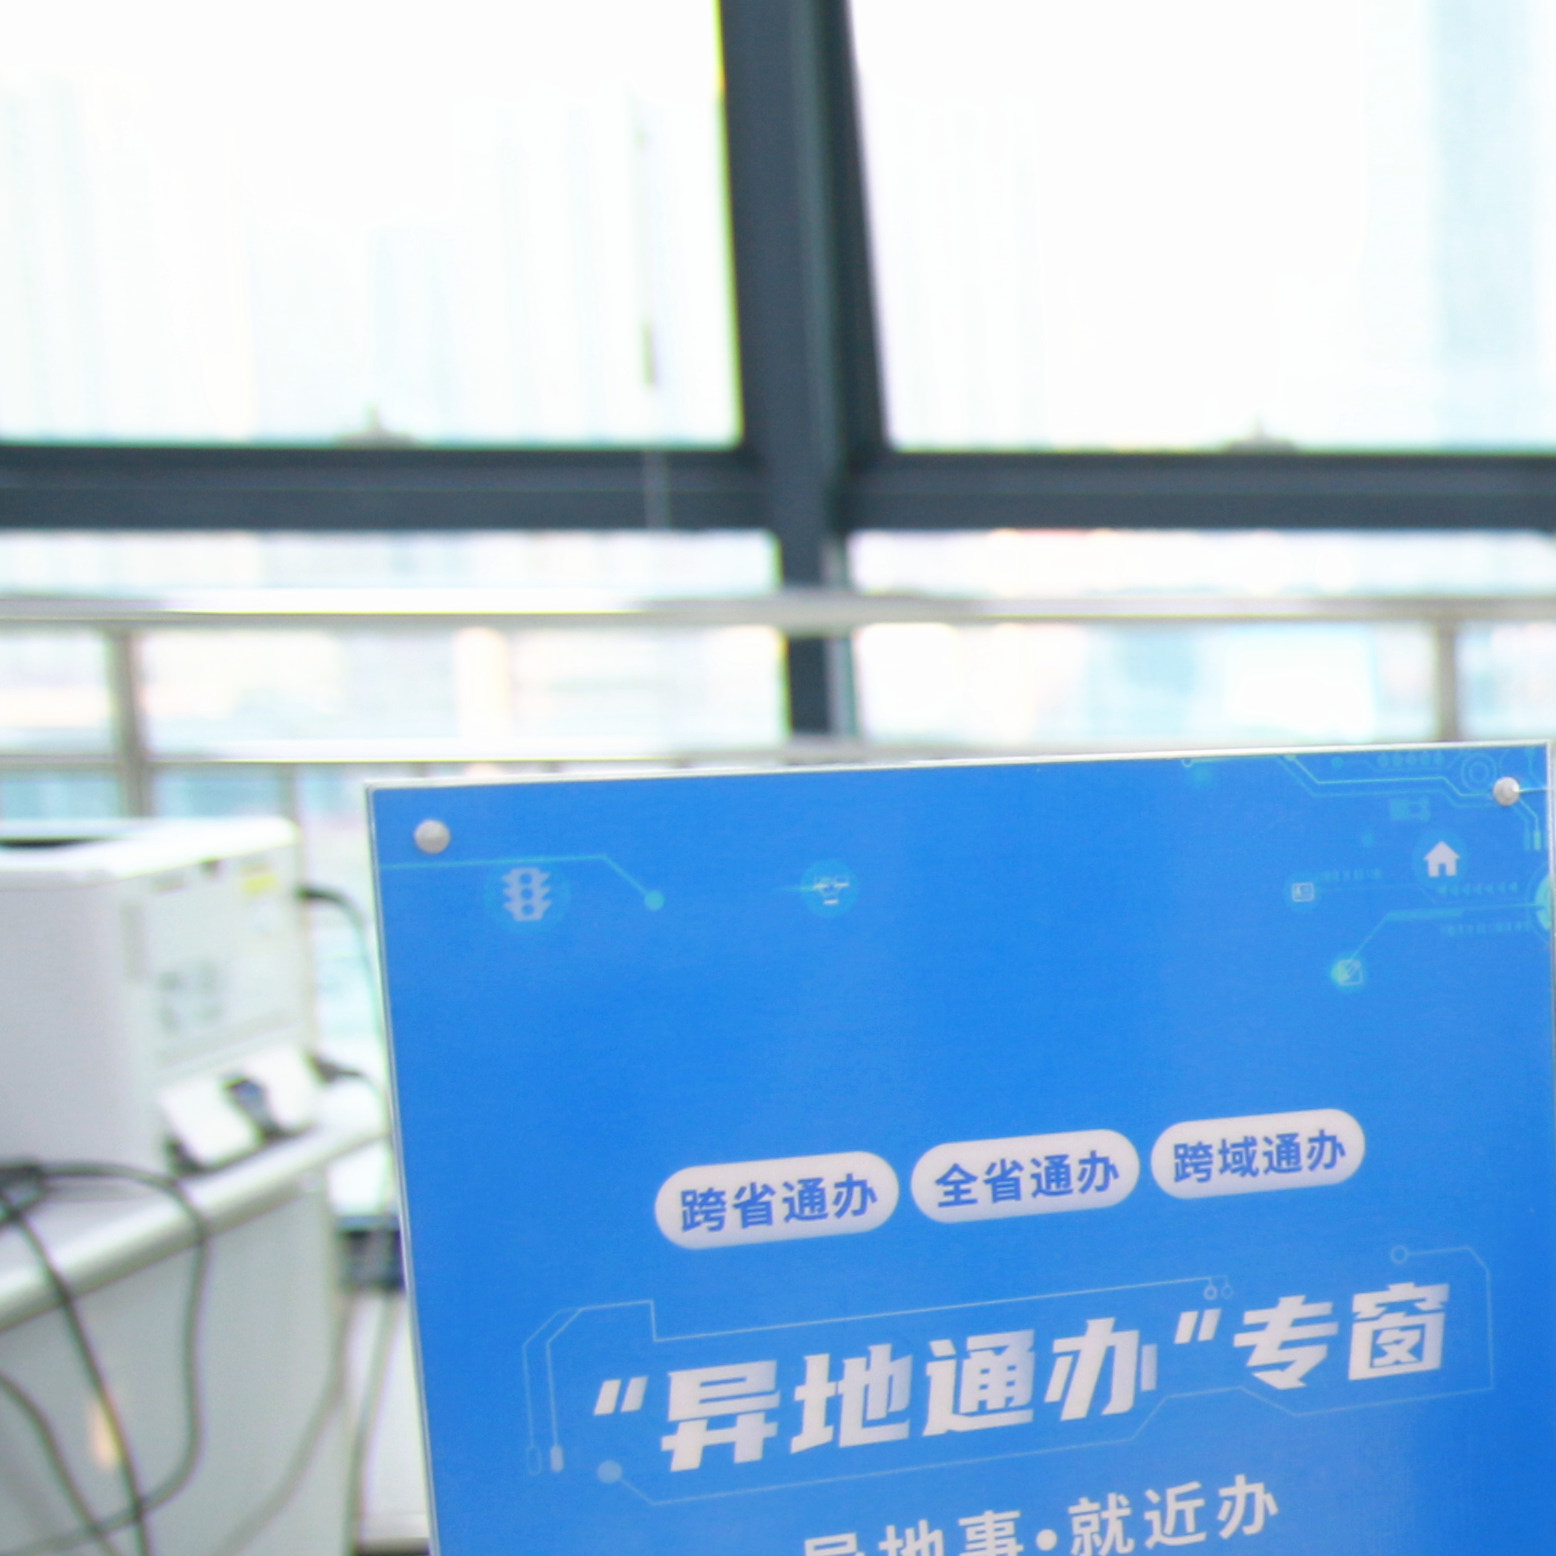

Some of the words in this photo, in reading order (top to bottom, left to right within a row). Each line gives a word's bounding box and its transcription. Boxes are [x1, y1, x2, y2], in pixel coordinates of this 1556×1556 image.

[679, 1172, 879, 1235] 跨省通办
[935, 1150, 1120, 1208] 全省通办
[1172, 1127, 1348, 1183] 跨域通办
